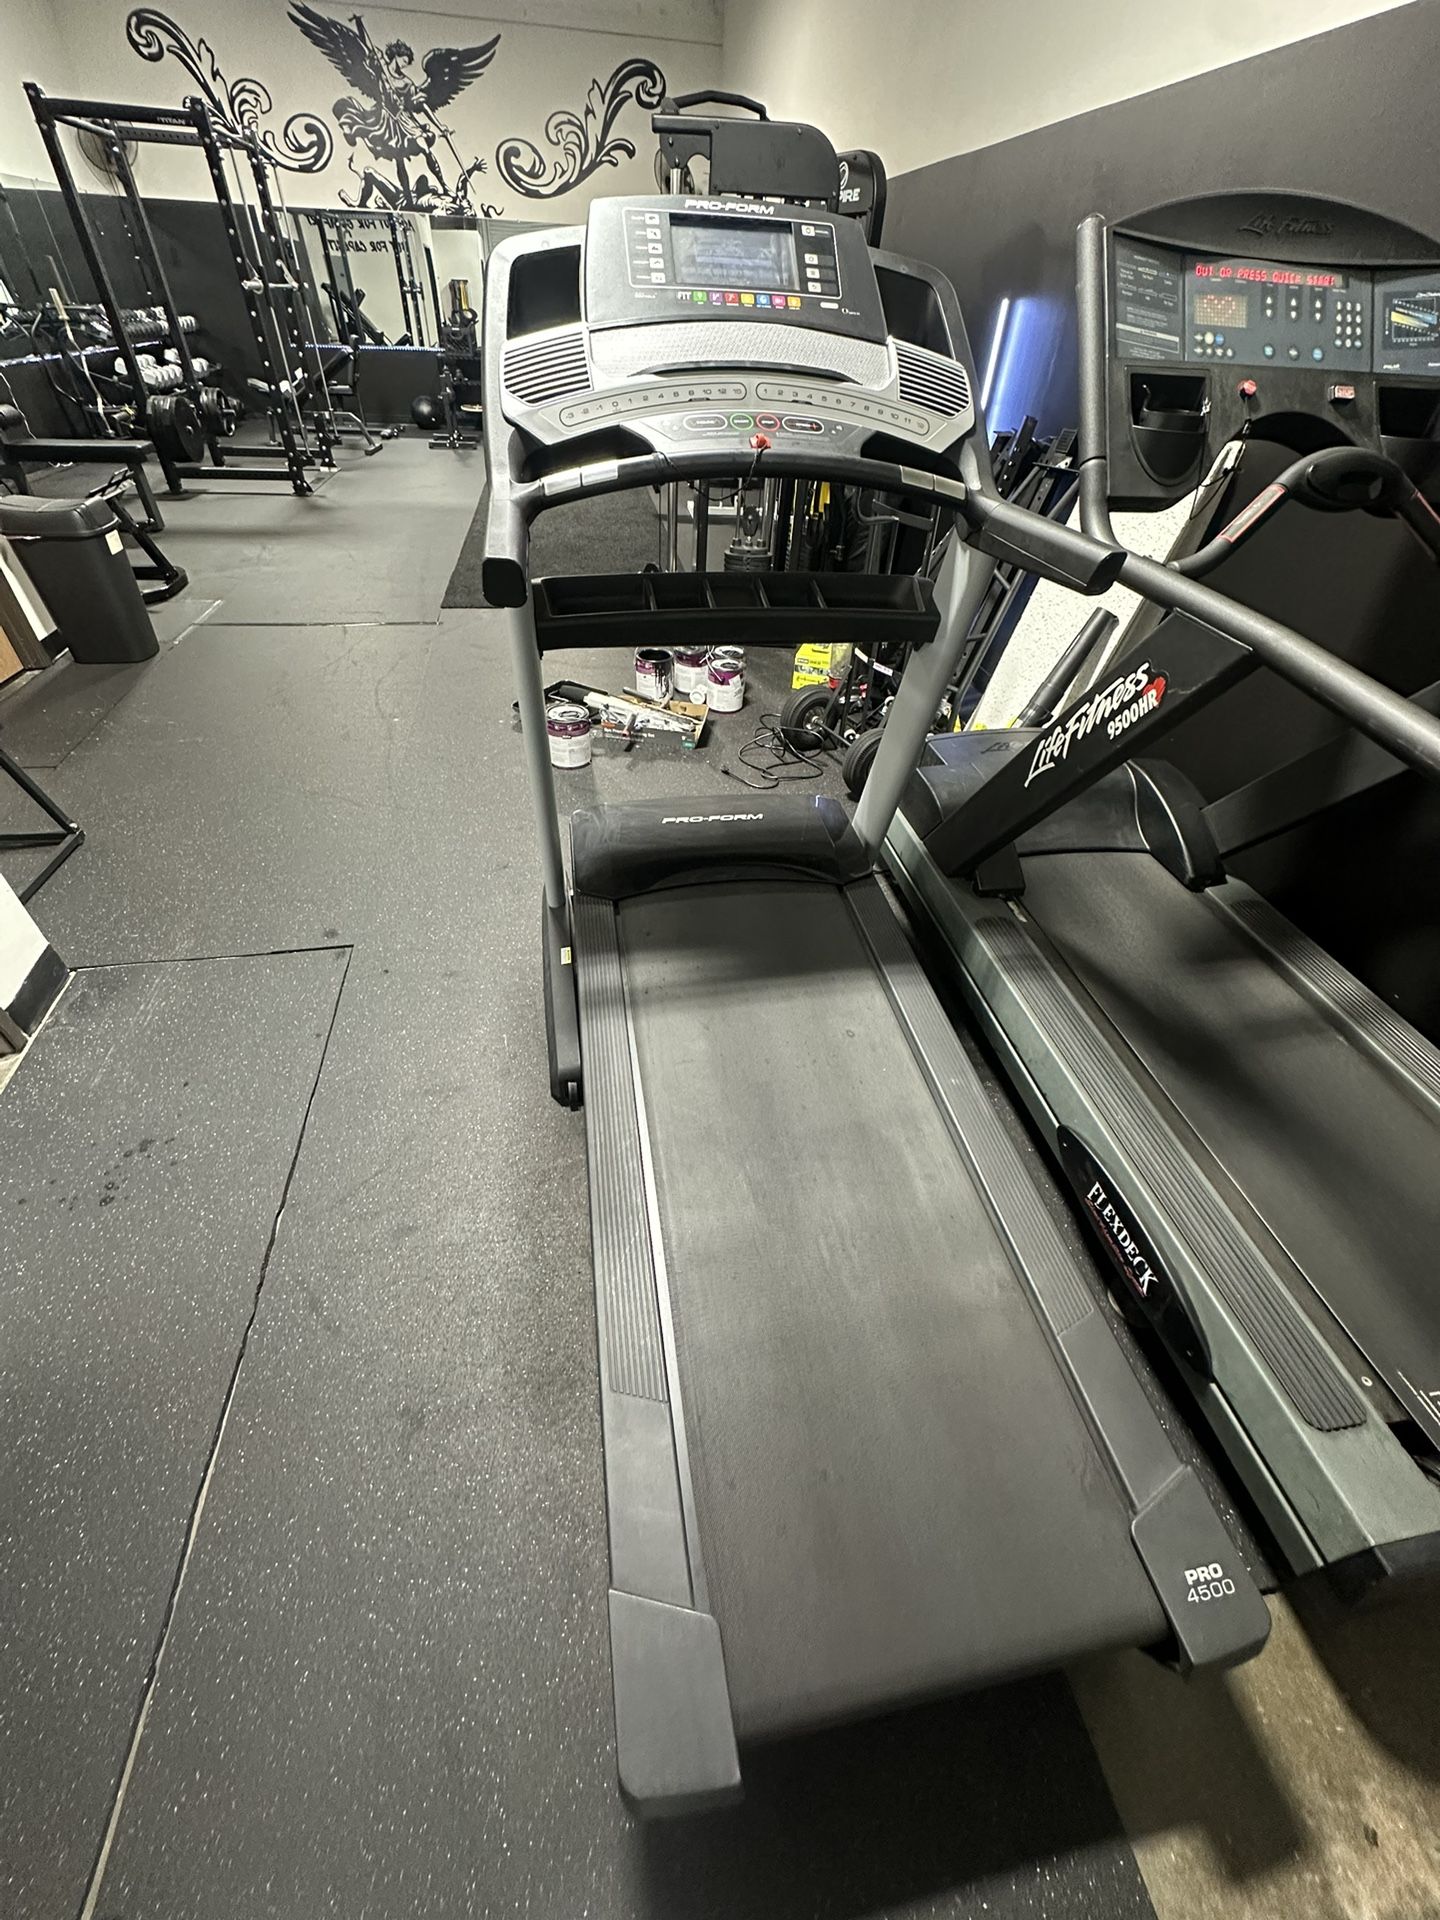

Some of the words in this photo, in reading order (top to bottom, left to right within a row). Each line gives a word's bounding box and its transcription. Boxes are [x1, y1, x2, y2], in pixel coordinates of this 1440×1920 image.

[684, 199, 775, 215] PRO-FORM
[1237, 268, 1267, 281] PRESS
[1107, 688, 1159, 740] 9500HR
[662, 814, 764, 824] PRO-FORM
[1087, 1181, 1159, 1297] FLEXDECK
[1184, 1562, 1223, 1585] PRO
[1187, 1578, 1236, 1603] 4500
